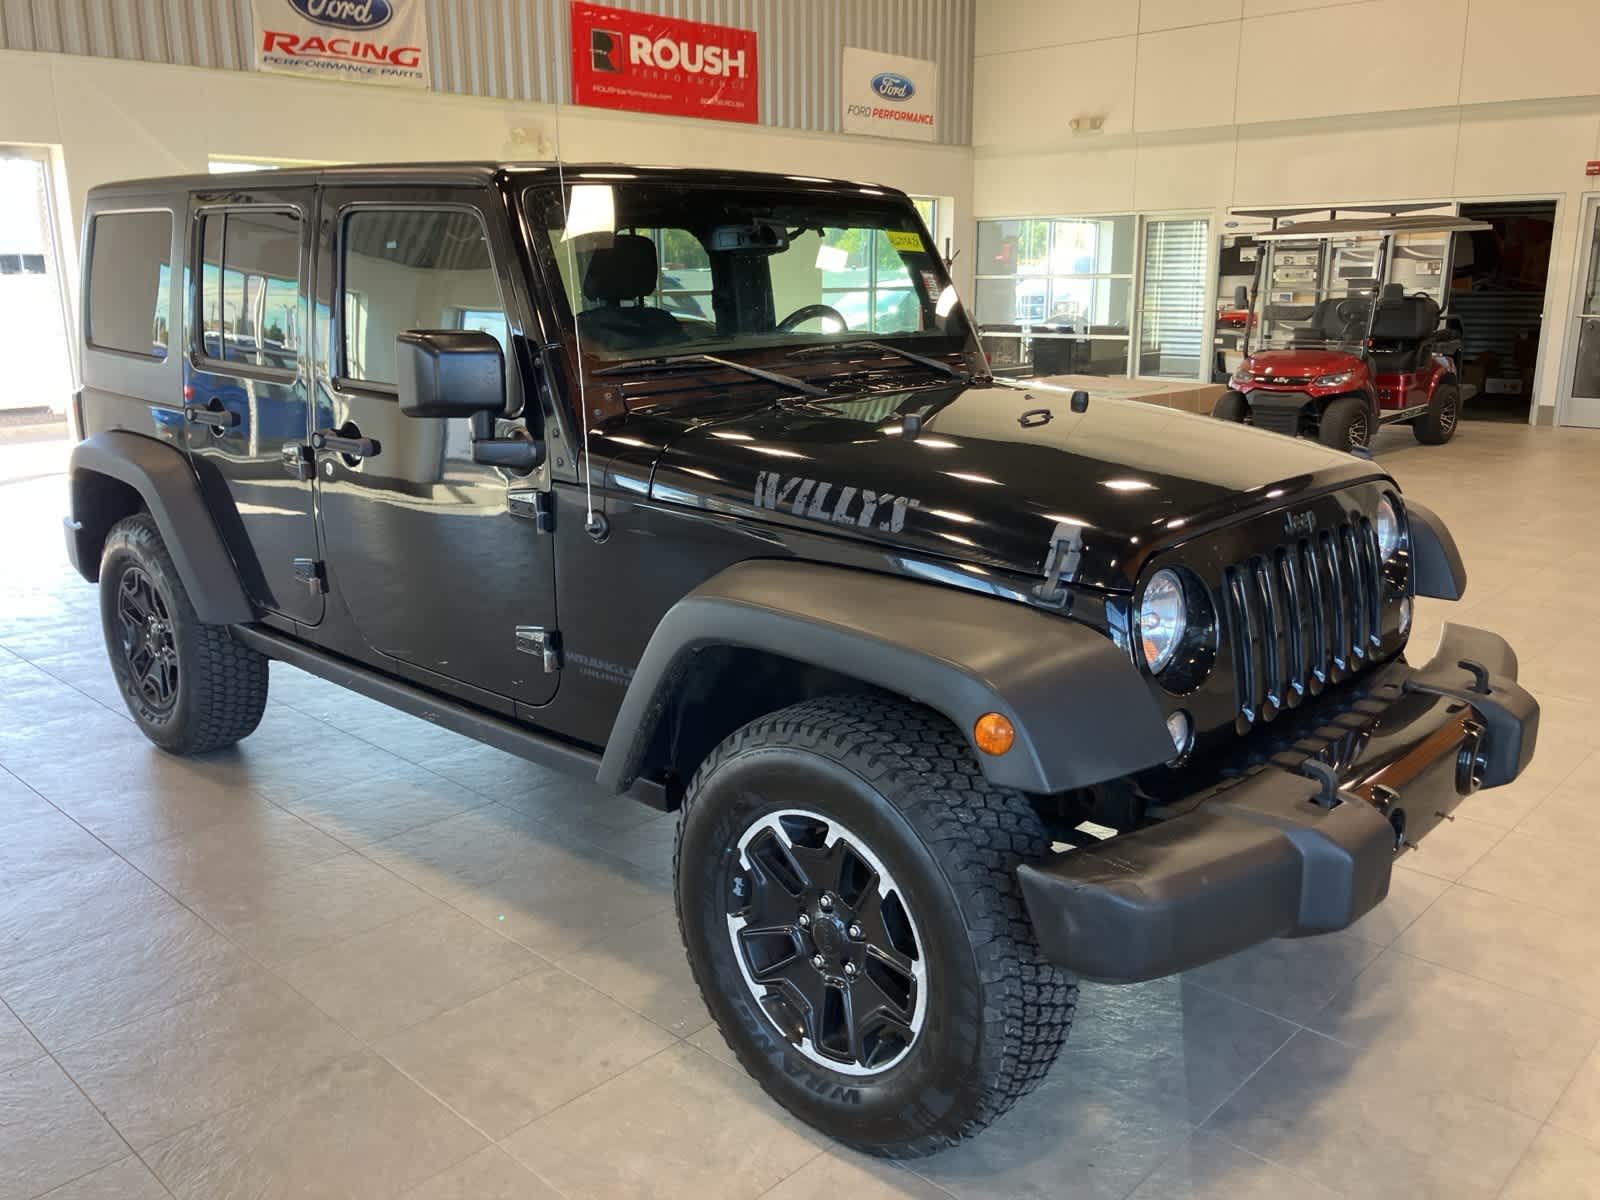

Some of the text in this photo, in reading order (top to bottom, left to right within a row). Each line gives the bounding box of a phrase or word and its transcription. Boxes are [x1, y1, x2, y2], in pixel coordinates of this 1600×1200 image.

[263, 30, 421, 67] RACING
[629, 34, 745, 78] ROUSH
[263, 55, 422, 79] PERFORMANCE PARTS
[879, 76, 907, 97] Ford
[847, 104, 935, 126] FORD PERFORMANCE
[753, 470, 921, 534] WILLYS
